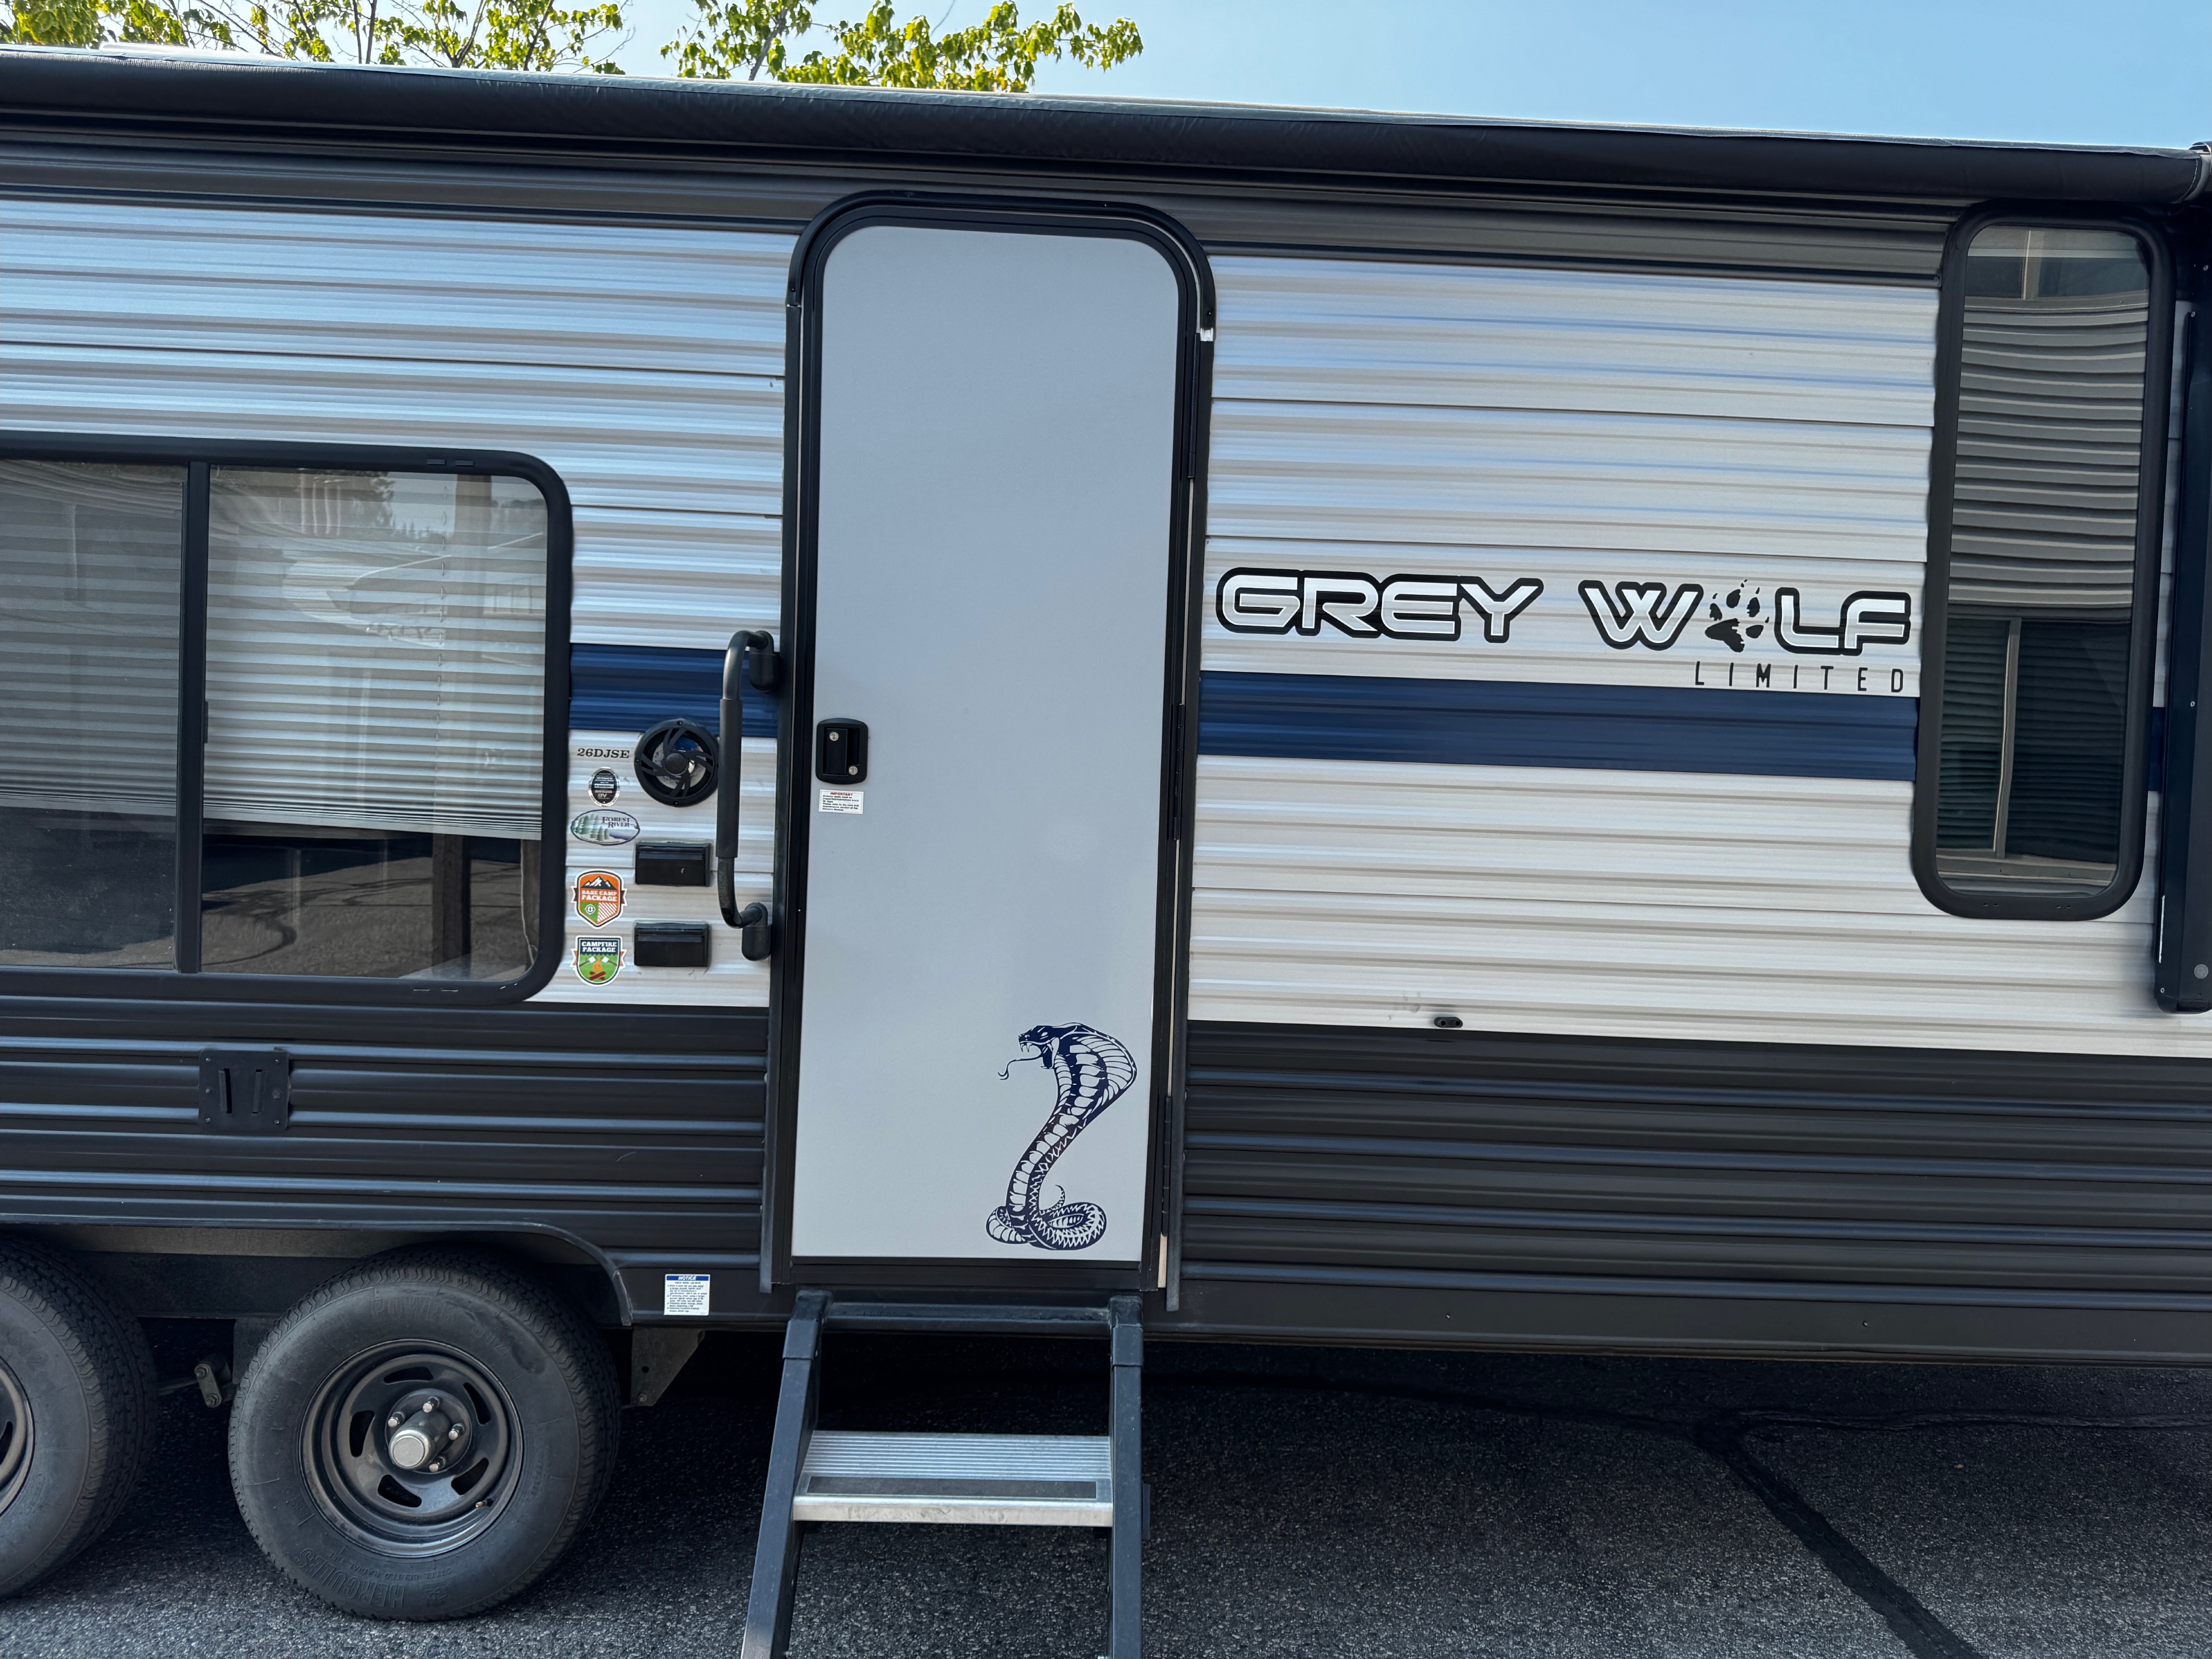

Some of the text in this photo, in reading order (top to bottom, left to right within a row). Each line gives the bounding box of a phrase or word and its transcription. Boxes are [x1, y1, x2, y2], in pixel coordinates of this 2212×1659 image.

[1216, 567, 1544, 643] GREY
[1695, 661, 1903, 693] LIMITED
[577, 748, 630, 758] 26DJSE
[371, 1295, 456, 1328] POWER
[296, 1547, 406, 1609] HERCULES
